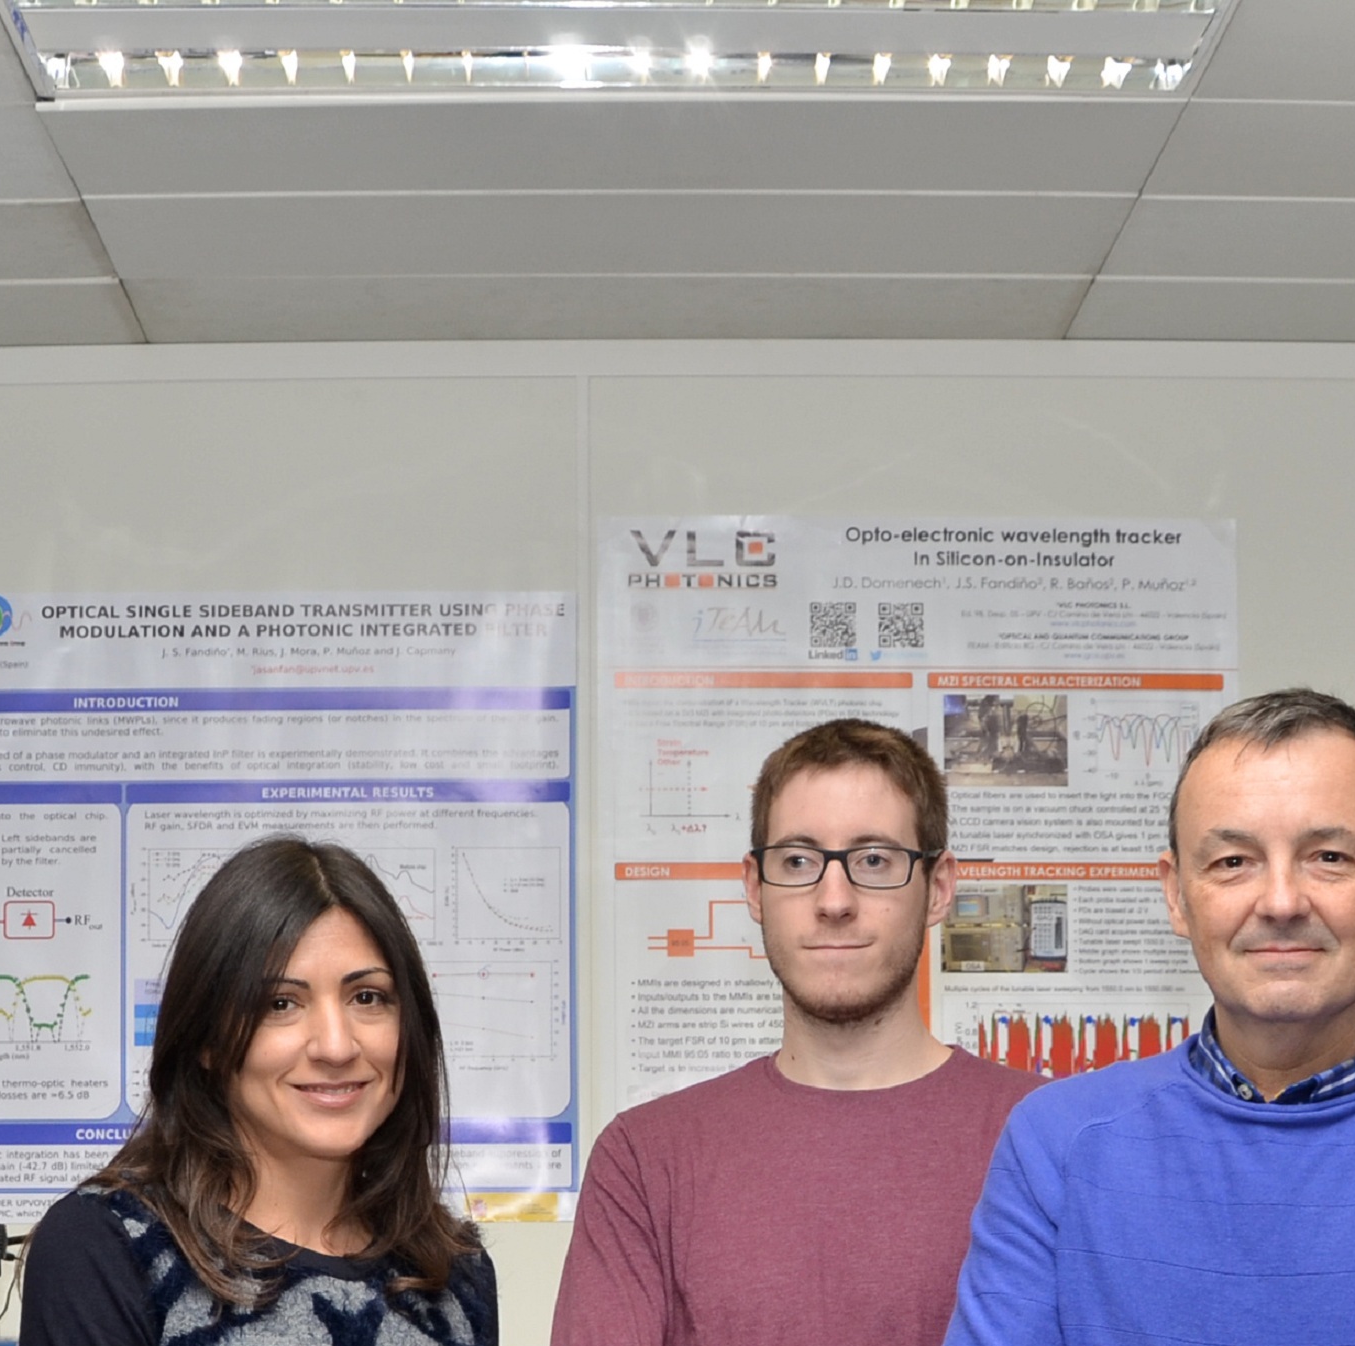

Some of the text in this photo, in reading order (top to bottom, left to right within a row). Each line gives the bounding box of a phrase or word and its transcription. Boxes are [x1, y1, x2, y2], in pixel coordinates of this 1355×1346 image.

[845, 526, 1181, 546] Opto-electronic wavelength tracker
[629, 530, 776, 567] VLC
[936, 550, 1114, 566] Silicon-on-Insulator
[41, 605, 119, 618] OPTICAL
[126, 605, 191, 618] SINGLE
[199, 604, 294, 617] SIDEBAND
[300, 603, 431, 617] TRANSMITTER
[59, 624, 184, 637] MODULATION
[191, 624, 231, 637] AND
[237, 624, 250, 636] A
[256, 623, 353, 636] PHOTONIC
[360, 623, 477, 636] INTEGRATED
[937, 676, 1141, 686] MZI SPECTRAL CHARACTERIZATION
[73, 697, 178, 707] INTRODUCTION
[40, 715, 81, 727] photonic
[87, 714, 109, 724] links
[113, 714, 159, 726] (MWPLs),
[162, 715, 187, 724] since
[202, 713, 248, 725] produces
[251, 713, 283, 725] fading
[286, 714, 323, 725] regions
[327, 713, 341, 724] (or
[345, 712, 388, 724] notches)
[0, 726, 9, 736] to
[11, 726, 57, 736] eliminate
[59, 726, 79, 736] this
[81, 726, 130, 736] undesired
[132, 725, 162, 735] effect.
[261, 787, 434, 797] EXPERIMENTAL RESULTS
[19, 811, 35, 819] the
[43, 811, 76, 821] optical
[84, 811, 107, 821] chip.
[1, 833, 20, 841] Left
[25, 833, 75, 841] sidebands
[1, 844, 97, 855] partially cancelled
[15, 856, 33, 864] the
[35, 856, 59, 864] filter.
[624, 866, 670, 876] DESIGN
[1023, 866, 1086, 876] TRACKING
[6, 887, 54, 897] Detector
